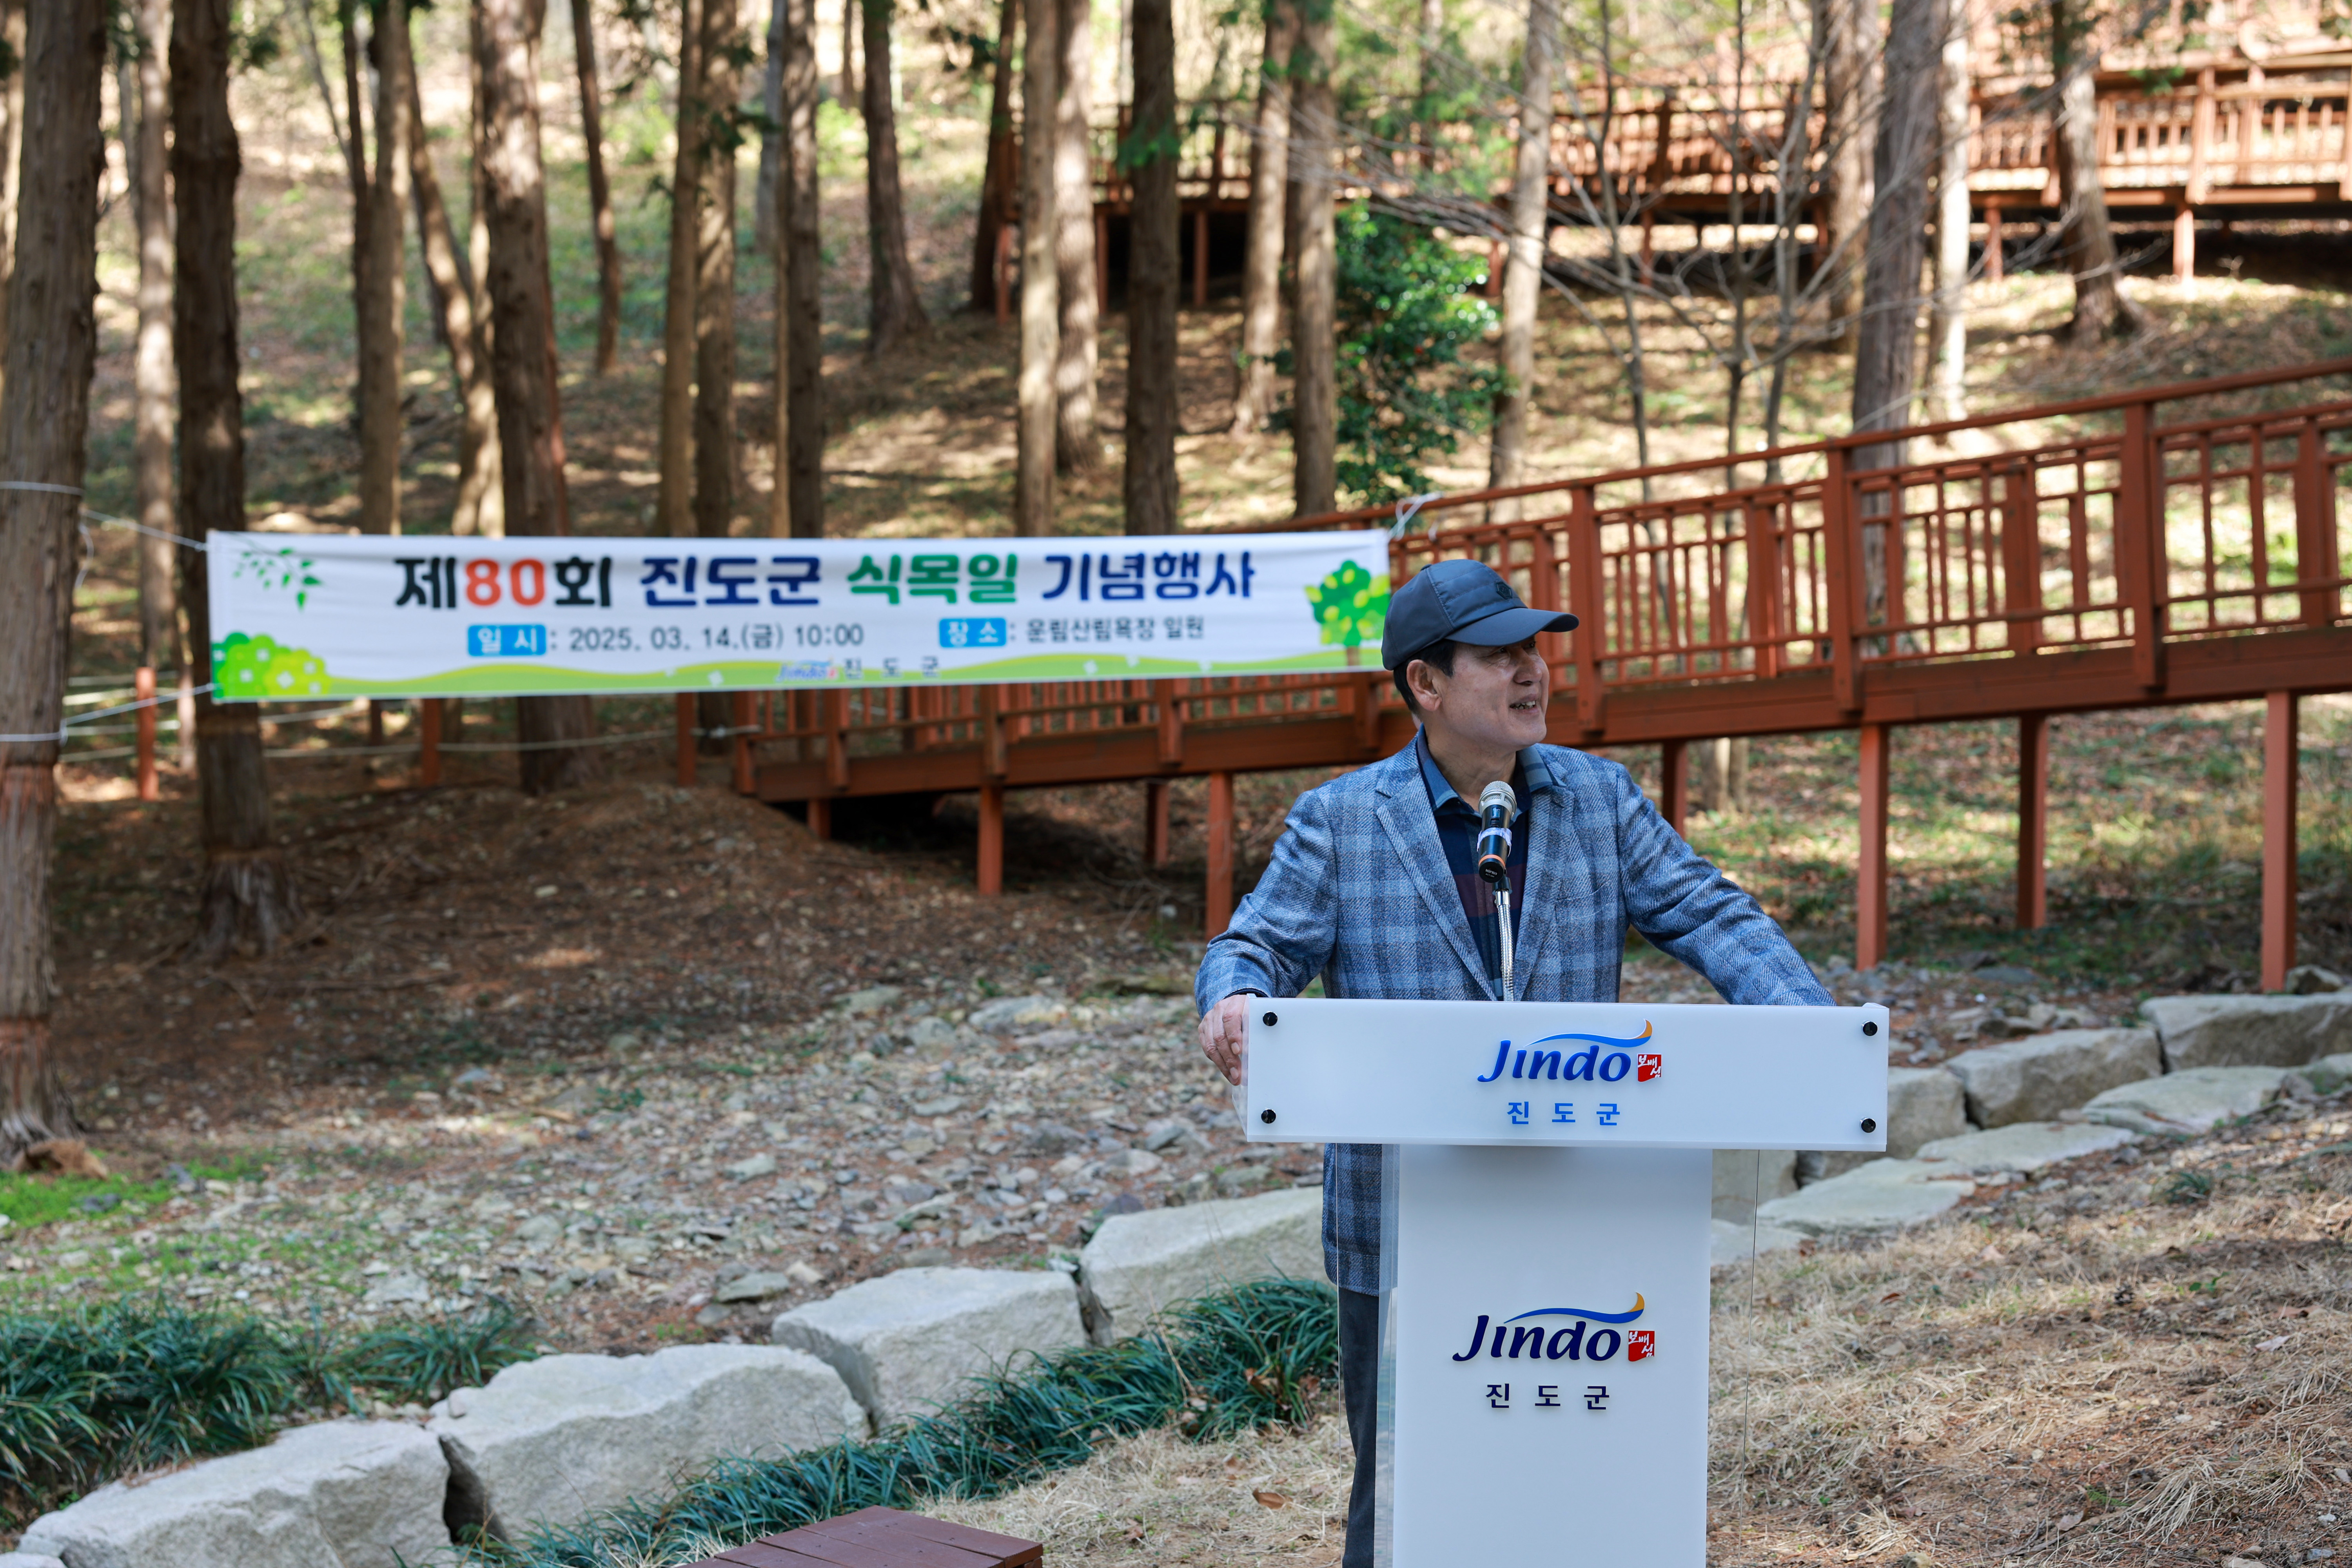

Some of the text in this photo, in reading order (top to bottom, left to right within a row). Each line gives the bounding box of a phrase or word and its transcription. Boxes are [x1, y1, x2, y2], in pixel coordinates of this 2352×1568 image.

[395, 552, 1256, 609] 제80회 진도군 식목일 기념행사
[570, 627, 641, 651] 2025.
[650, 626, 691, 651] 03.
[795, 623, 864, 647] 10:00
[1477, 1040, 1631, 1082] Jindo
[1452, 1315, 1621, 1361] Jindo
